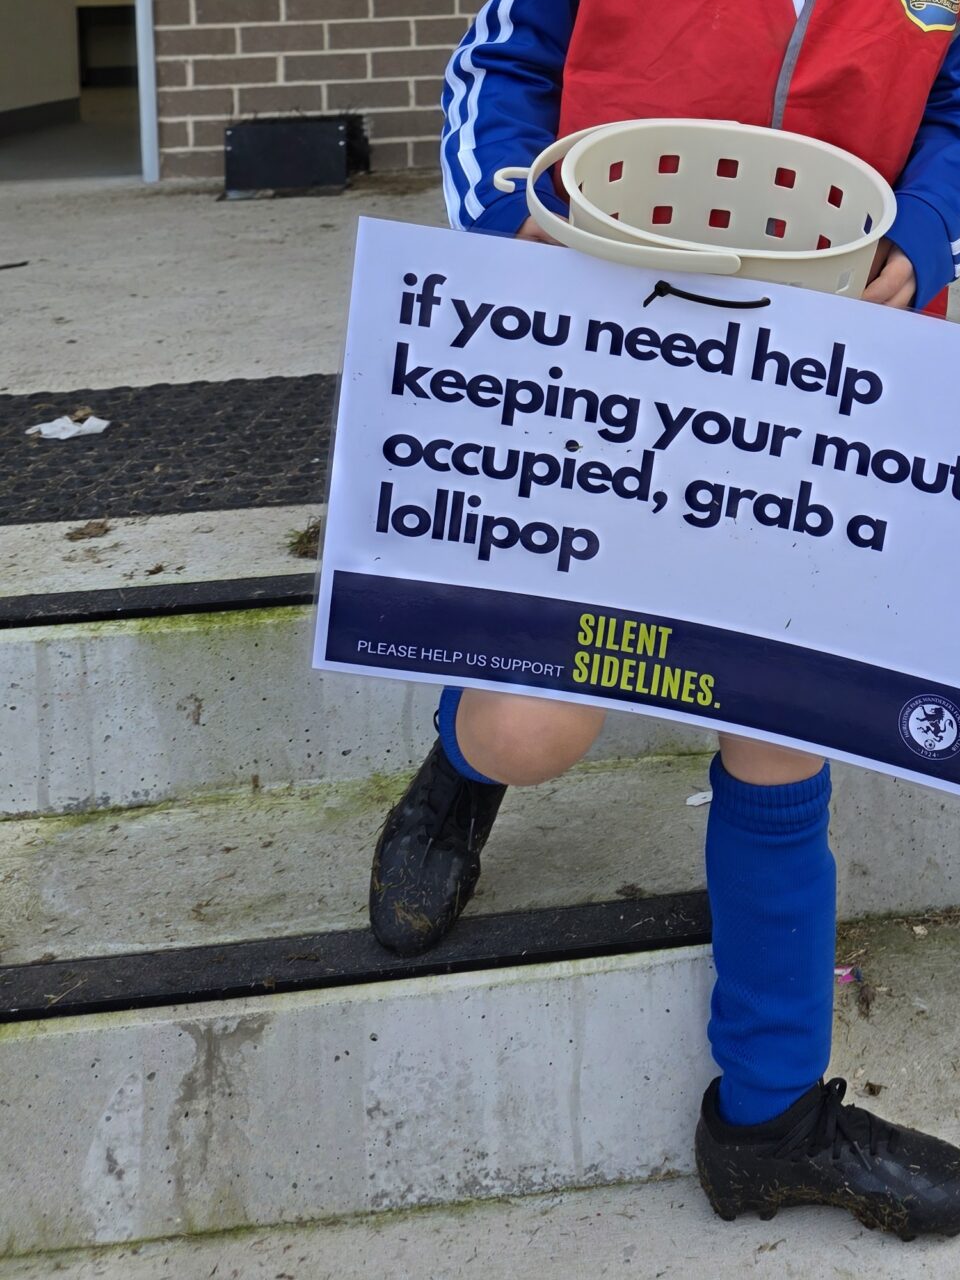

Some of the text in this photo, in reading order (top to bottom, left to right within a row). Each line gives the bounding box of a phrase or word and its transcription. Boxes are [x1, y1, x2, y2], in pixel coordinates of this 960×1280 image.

[399, 272, 883, 416] if you need help
[391, 341, 640, 443] keeping
[652, 401, 802, 458] your
[375, 481, 599, 572] lollipop
[382, 433, 888, 552] occupied, grab a
[356, 640, 565, 678] PLEASE HELP US SUPPORT
[572, 651, 721, 709] SIDELINES.
[577, 613, 673, 660] SILENT
